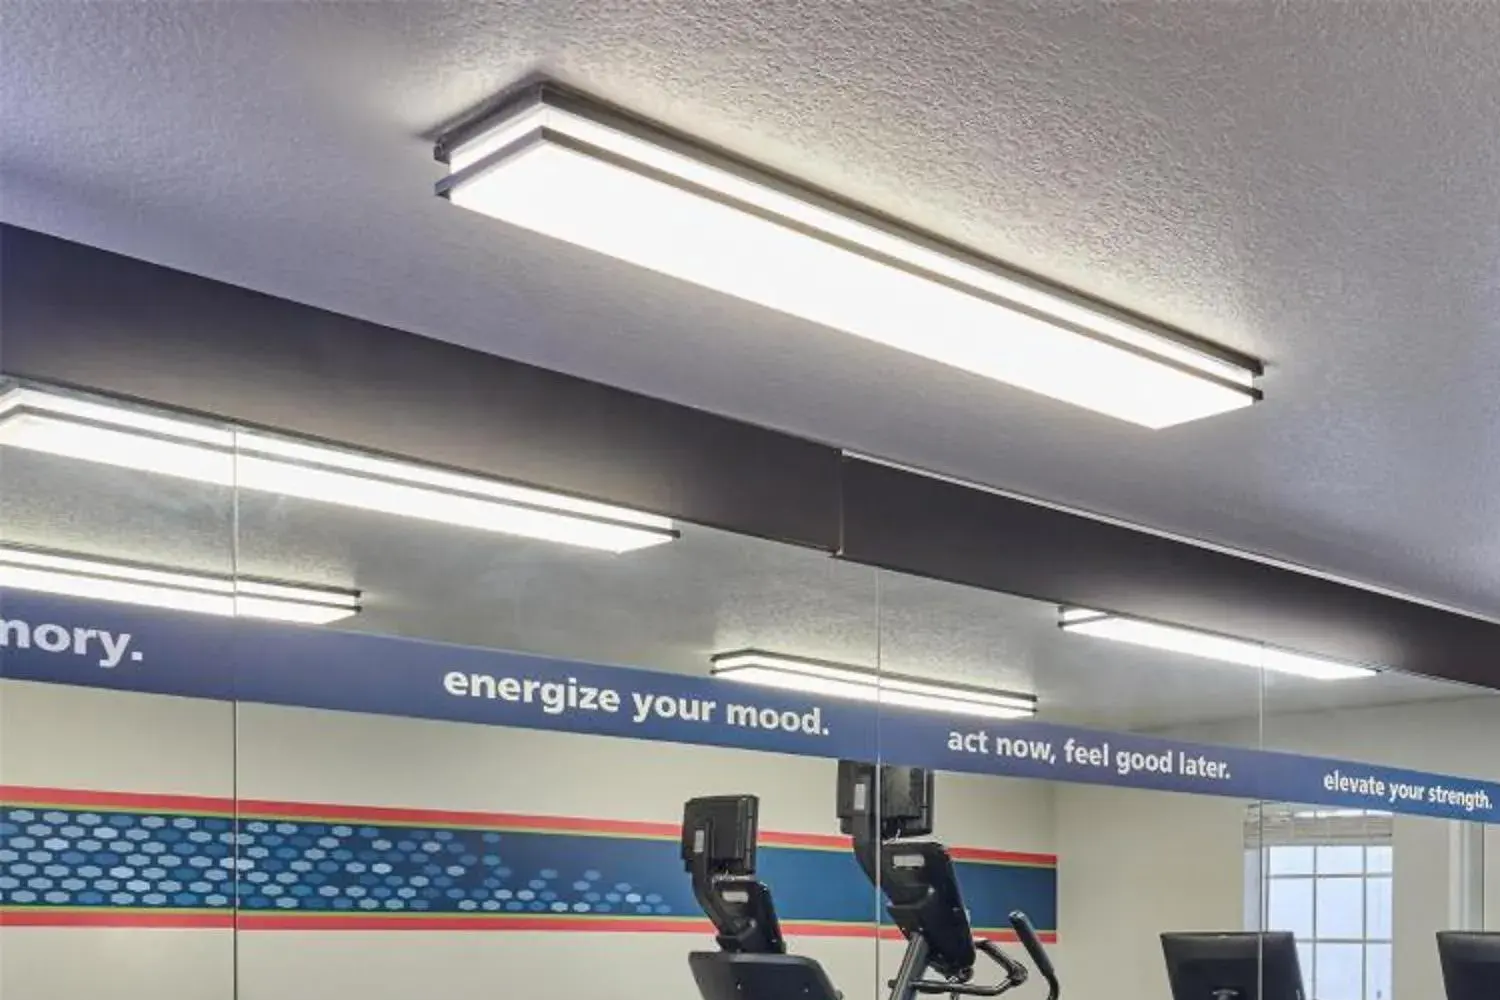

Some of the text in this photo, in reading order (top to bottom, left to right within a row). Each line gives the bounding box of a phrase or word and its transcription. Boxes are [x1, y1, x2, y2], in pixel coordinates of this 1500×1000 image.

[443, 671, 831, 736] energize your mood.
[947, 730, 1231, 780] act now, feel good later.
[1323, 769, 1493, 812] elevate your strength.
